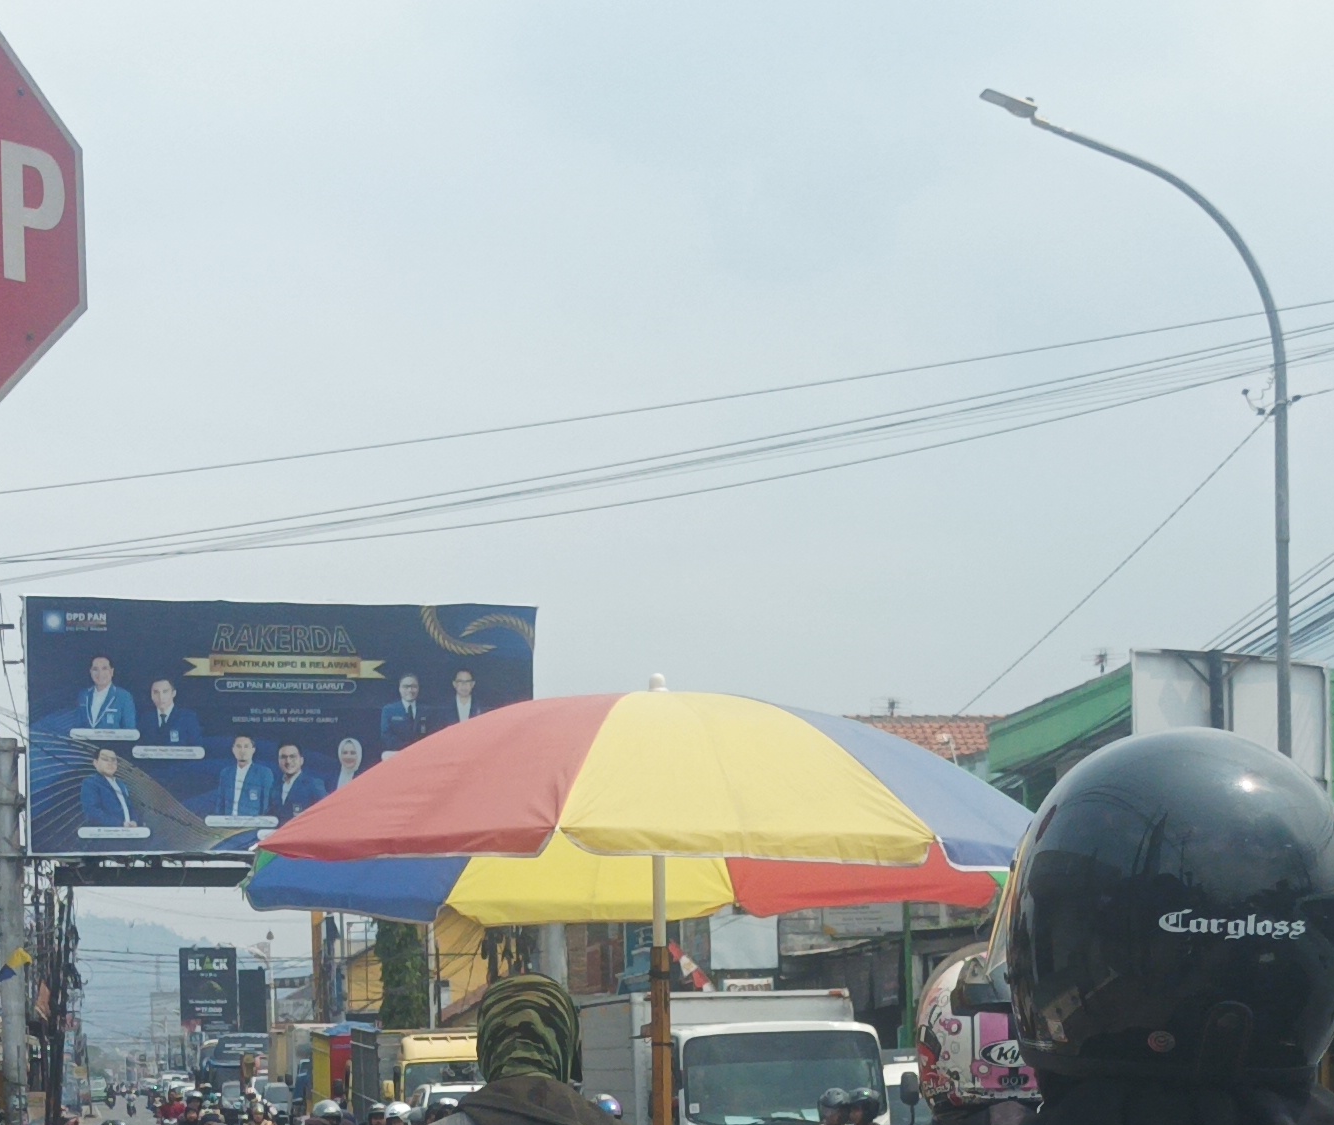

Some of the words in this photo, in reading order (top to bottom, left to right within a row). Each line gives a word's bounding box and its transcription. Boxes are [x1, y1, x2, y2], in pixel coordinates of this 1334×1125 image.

[66, 612, 85, 621] DPD
[87, 612, 107, 621] PAN
[211, 623, 356, 653] RAKERDA
[213, 659, 275, 668] PELANTIKAN
[309, 661, 357, 669] RELAWAN
[246, 681, 263, 689] PAN
[316, 682, 345, 690] GARUT
[1158, 909, 1306, 940] Cargloss
[1001, 1077, 1025, 1086] DOT
